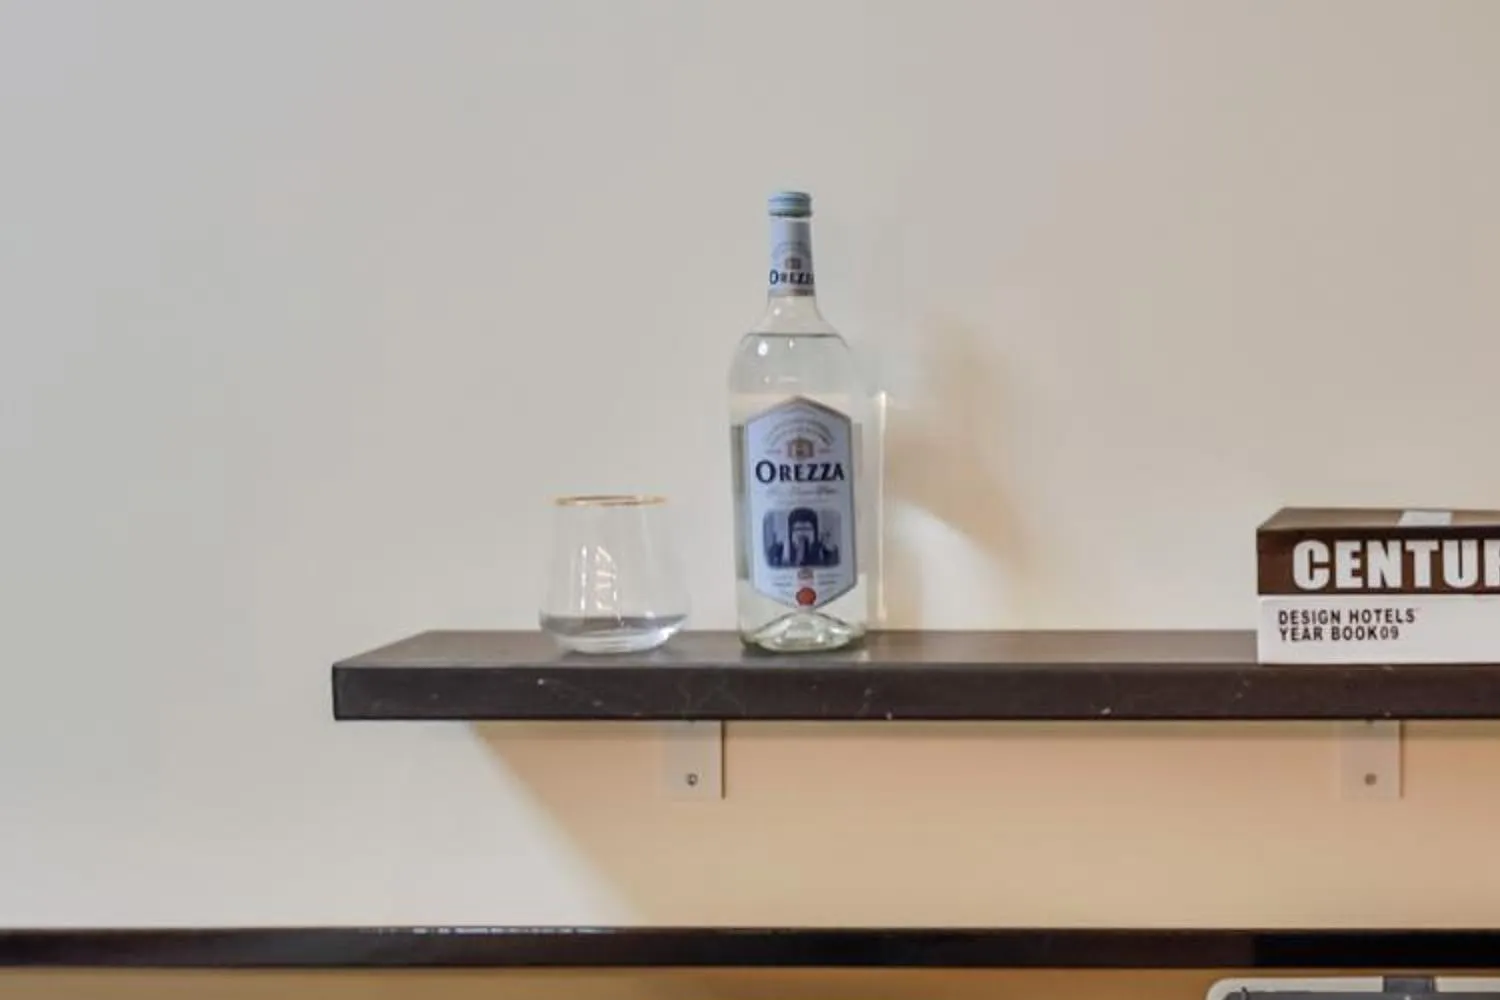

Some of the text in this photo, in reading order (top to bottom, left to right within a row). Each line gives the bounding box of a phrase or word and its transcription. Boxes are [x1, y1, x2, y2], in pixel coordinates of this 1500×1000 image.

[755, 459, 845, 484] OREZZA
[1278, 608, 1416, 625] DESIGN HOTELS
[1279, 626, 1323, 642] YEAR
